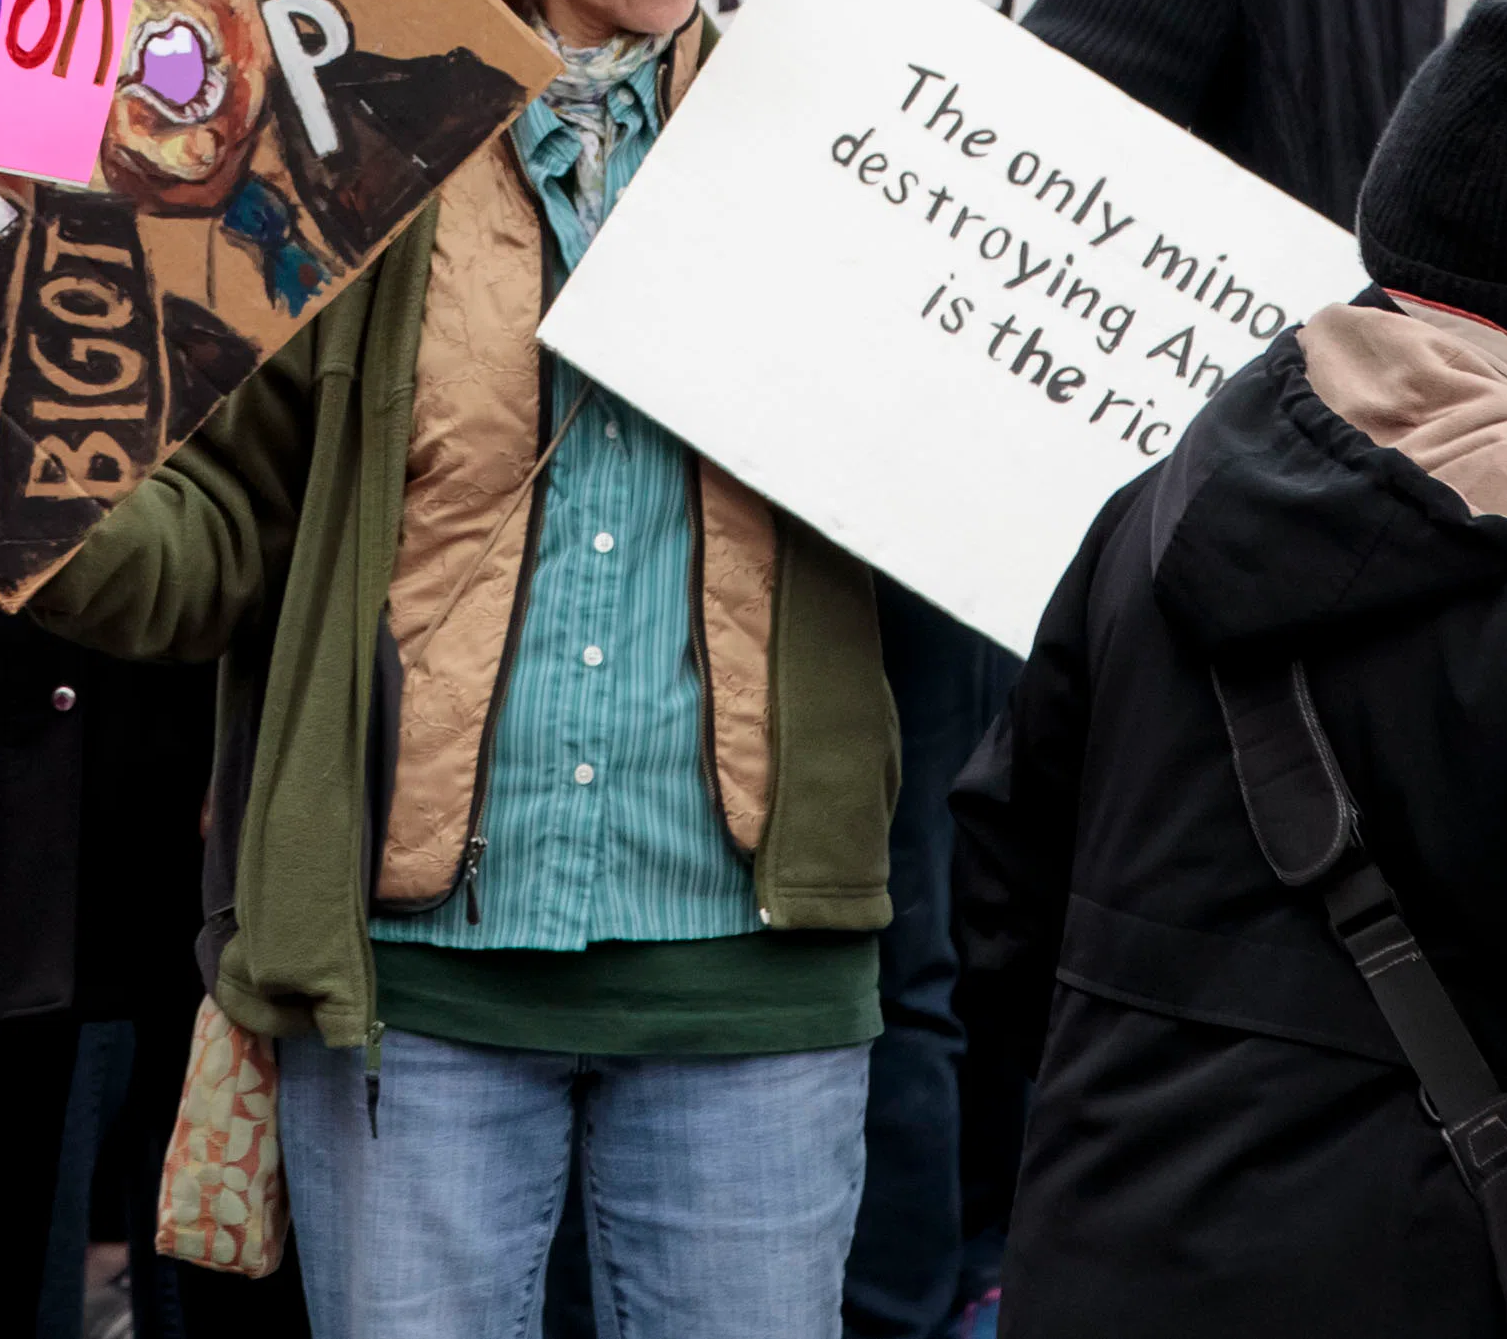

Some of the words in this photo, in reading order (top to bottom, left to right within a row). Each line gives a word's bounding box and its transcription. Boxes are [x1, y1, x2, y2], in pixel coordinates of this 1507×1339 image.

[829, 126, 1138, 354] destroying
[895, 62, 998, 164] The
[1006, 149, 1137, 255] only
[1141, 232, 1288, 340] mino
[24, 218, 156, 502] BIGOT
[921, 273, 978, 331] is
[986, 312, 1088, 404] the
[1088, 388, 1172, 456] ric
